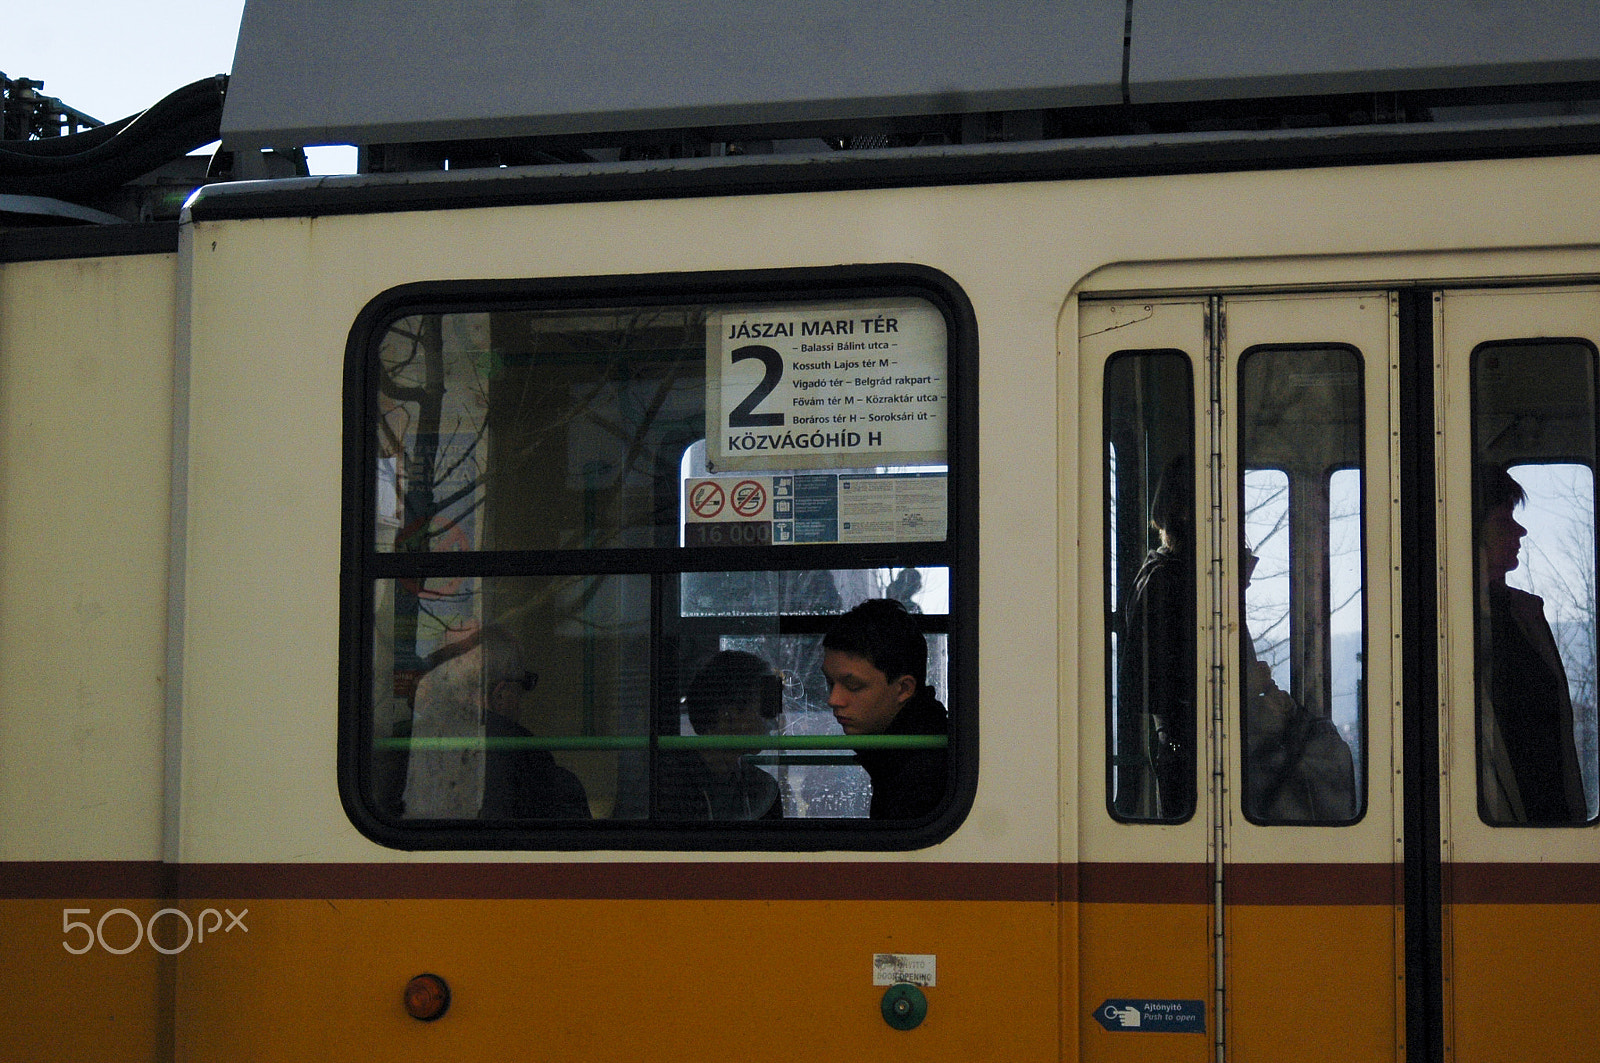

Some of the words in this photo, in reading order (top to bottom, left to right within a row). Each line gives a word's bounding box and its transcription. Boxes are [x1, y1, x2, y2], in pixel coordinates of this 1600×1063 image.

[729, 321, 793, 339] JÁSZAI
[802, 320, 853, 336] MARI
[861, 315, 898, 333] TÉR
[802, 343, 834, 353] Balassi
[838, 342, 865, 351] Bálint
[868, 342, 889, 350] utca
[793, 361, 831, 371] Kossuth
[835, 361, 860, 371] Lajos
[862, 359, 877, 368] tér
[880, 359, 889, 368] M
[729, 345, 784, 427] 2
[793, 379, 827, 390] Vigadó
[830, 379, 844, 387] tér
[855, 377, 892, 388] Belgrád
[896, 376, 932, 387] rakpart
[828, 397, 842, 406] tér
[845, 397, 855, 405] M
[866, 394, 914, 404] Közraktár
[793, 416, 830, 425] Boráros
[833, 415, 847, 423] tér
[850, 415, 857, 423] H
[869, 412, 914, 422] Soroksári
[918, 412, 928, 421] út
[729, 429, 860, 450] KÖZVÁGÓHÍD
[869, 432, 881, 446] H
[699, 525, 723, 543] 16
[729, 524, 770, 542] 000
[1144, 1003, 1182, 1012] Ajtónyitó
[1165, 1013, 1174, 1021] to
[1176, 1014, 1196, 1022] open
